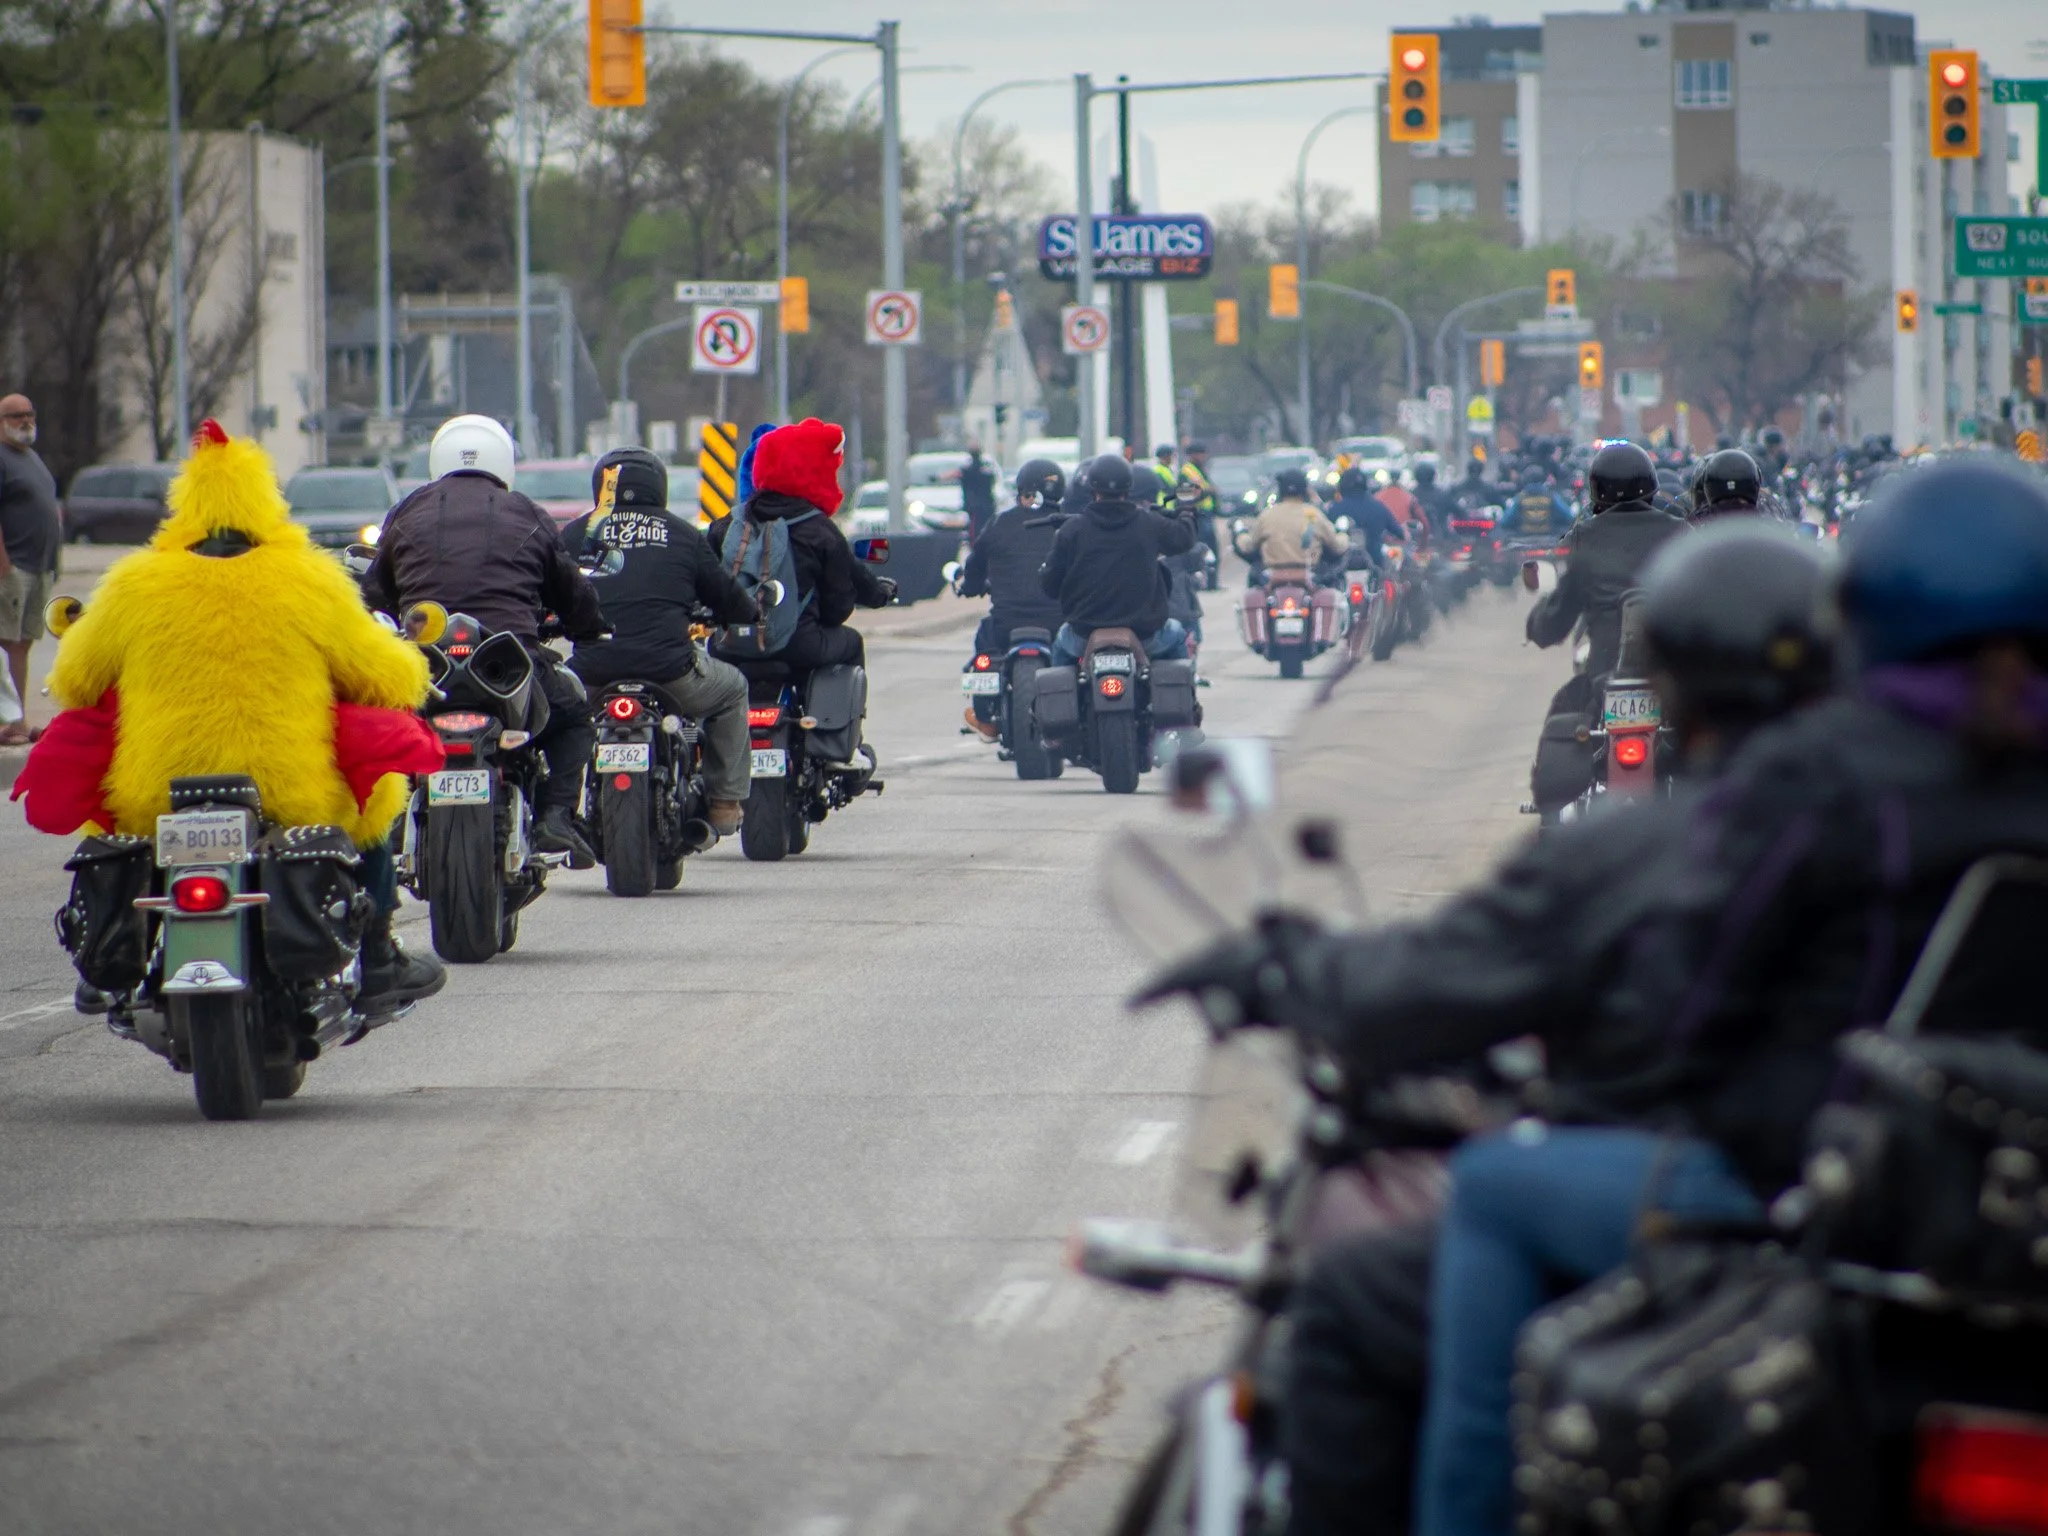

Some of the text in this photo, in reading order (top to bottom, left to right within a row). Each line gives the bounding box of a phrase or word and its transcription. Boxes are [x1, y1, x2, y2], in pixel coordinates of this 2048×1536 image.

[1093, 219, 1203, 257] James
[1971, 226, 2002, 246] 90
[637, 525, 669, 542] RIDE
[605, 749, 641, 763] 3FS62
[438, 775, 480, 793] 4FC73
